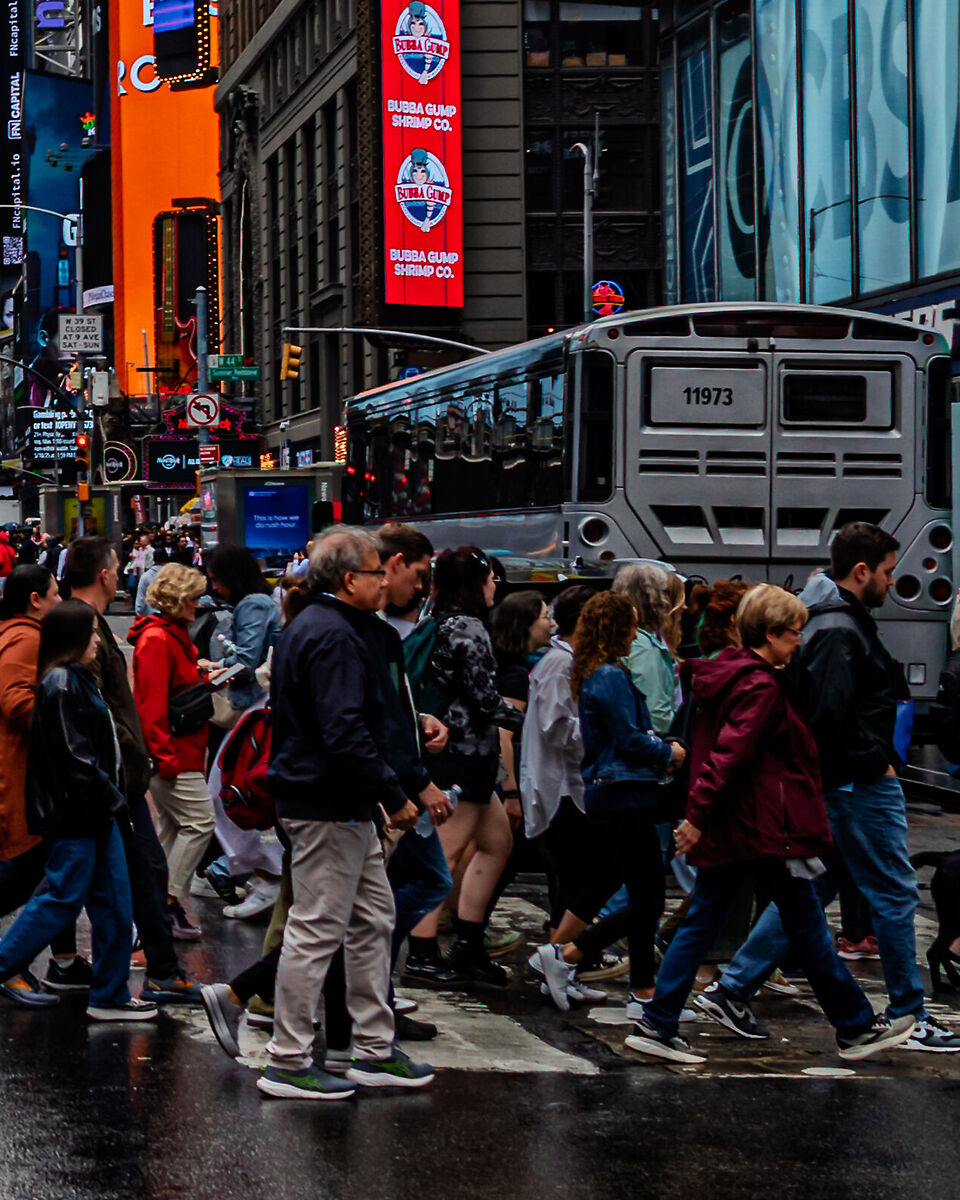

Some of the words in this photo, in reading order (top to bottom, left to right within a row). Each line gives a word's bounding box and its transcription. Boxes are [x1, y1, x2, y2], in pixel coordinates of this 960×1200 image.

[394, 37, 423, 53] BUBBA
[424, 38, 448, 57] GUMP
[10, 72, 21, 119] CAPITAL
[387, 99, 424, 115] BUBBA
[425, 103, 457, 117] GUMP
[392, 115, 432, 129] SHRIMP
[433, 119, 453, 131] CO.
[10, 153, 22, 229] FNcapital.io
[396, 185, 425, 201] BUBBA
[426, 186, 450, 203] GUMP
[390, 248, 426, 263] BUBBA
[427, 251, 459, 264] GUMP
[394, 263, 434, 277] SHRIMP
[436, 265, 455, 279] CO.
[62, 341, 76, 349] SAT
[84, 341, 100, 349] SUN
[82, 333, 100, 341] AVE
[683, 386, 734, 406] 11973
